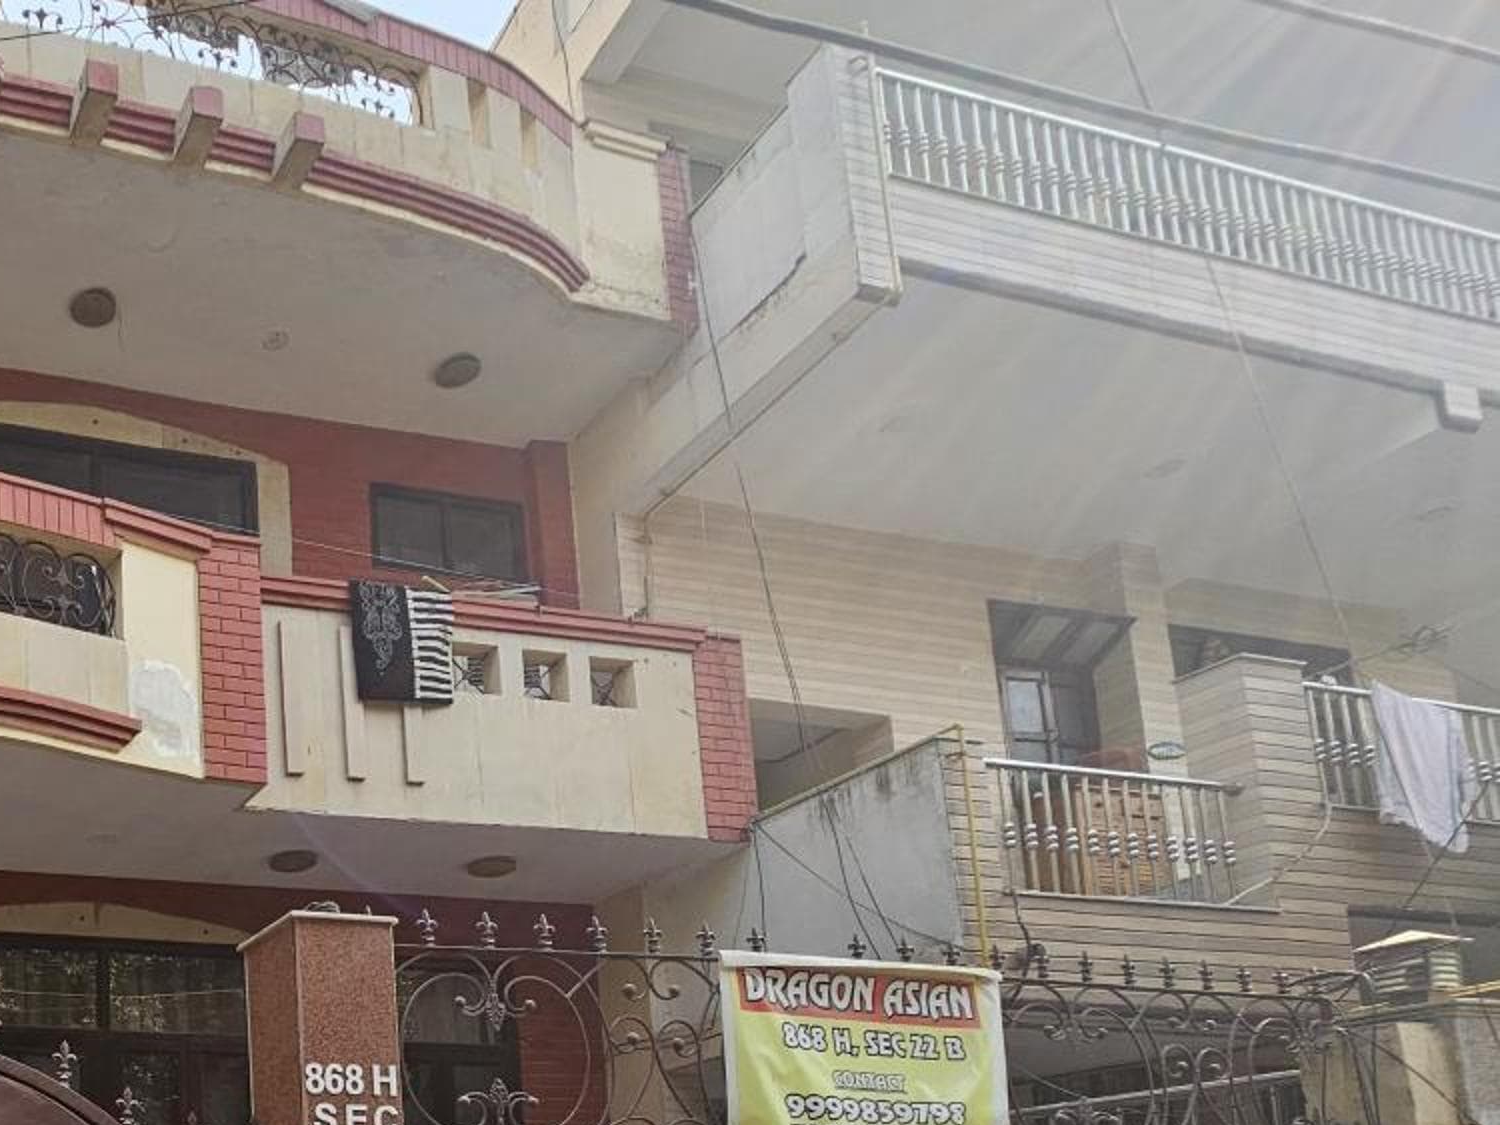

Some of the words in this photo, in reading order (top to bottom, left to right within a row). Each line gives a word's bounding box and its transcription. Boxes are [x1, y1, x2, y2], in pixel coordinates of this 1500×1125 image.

[743, 967, 876, 1013] DRAGON
[883, 980, 975, 1021] ASIAN
[782, 1021, 827, 1051] 868
[832, 1028, 860, 1056] H.
[864, 1030, 907, 1057] SEC
[909, 1034, 940, 1060] 22
[944, 1036, 967, 1060] B
[305, 1061, 365, 1095] 868
[371, 1063, 399, 1097] H
[832, 1070, 907, 1093] CONTACT
